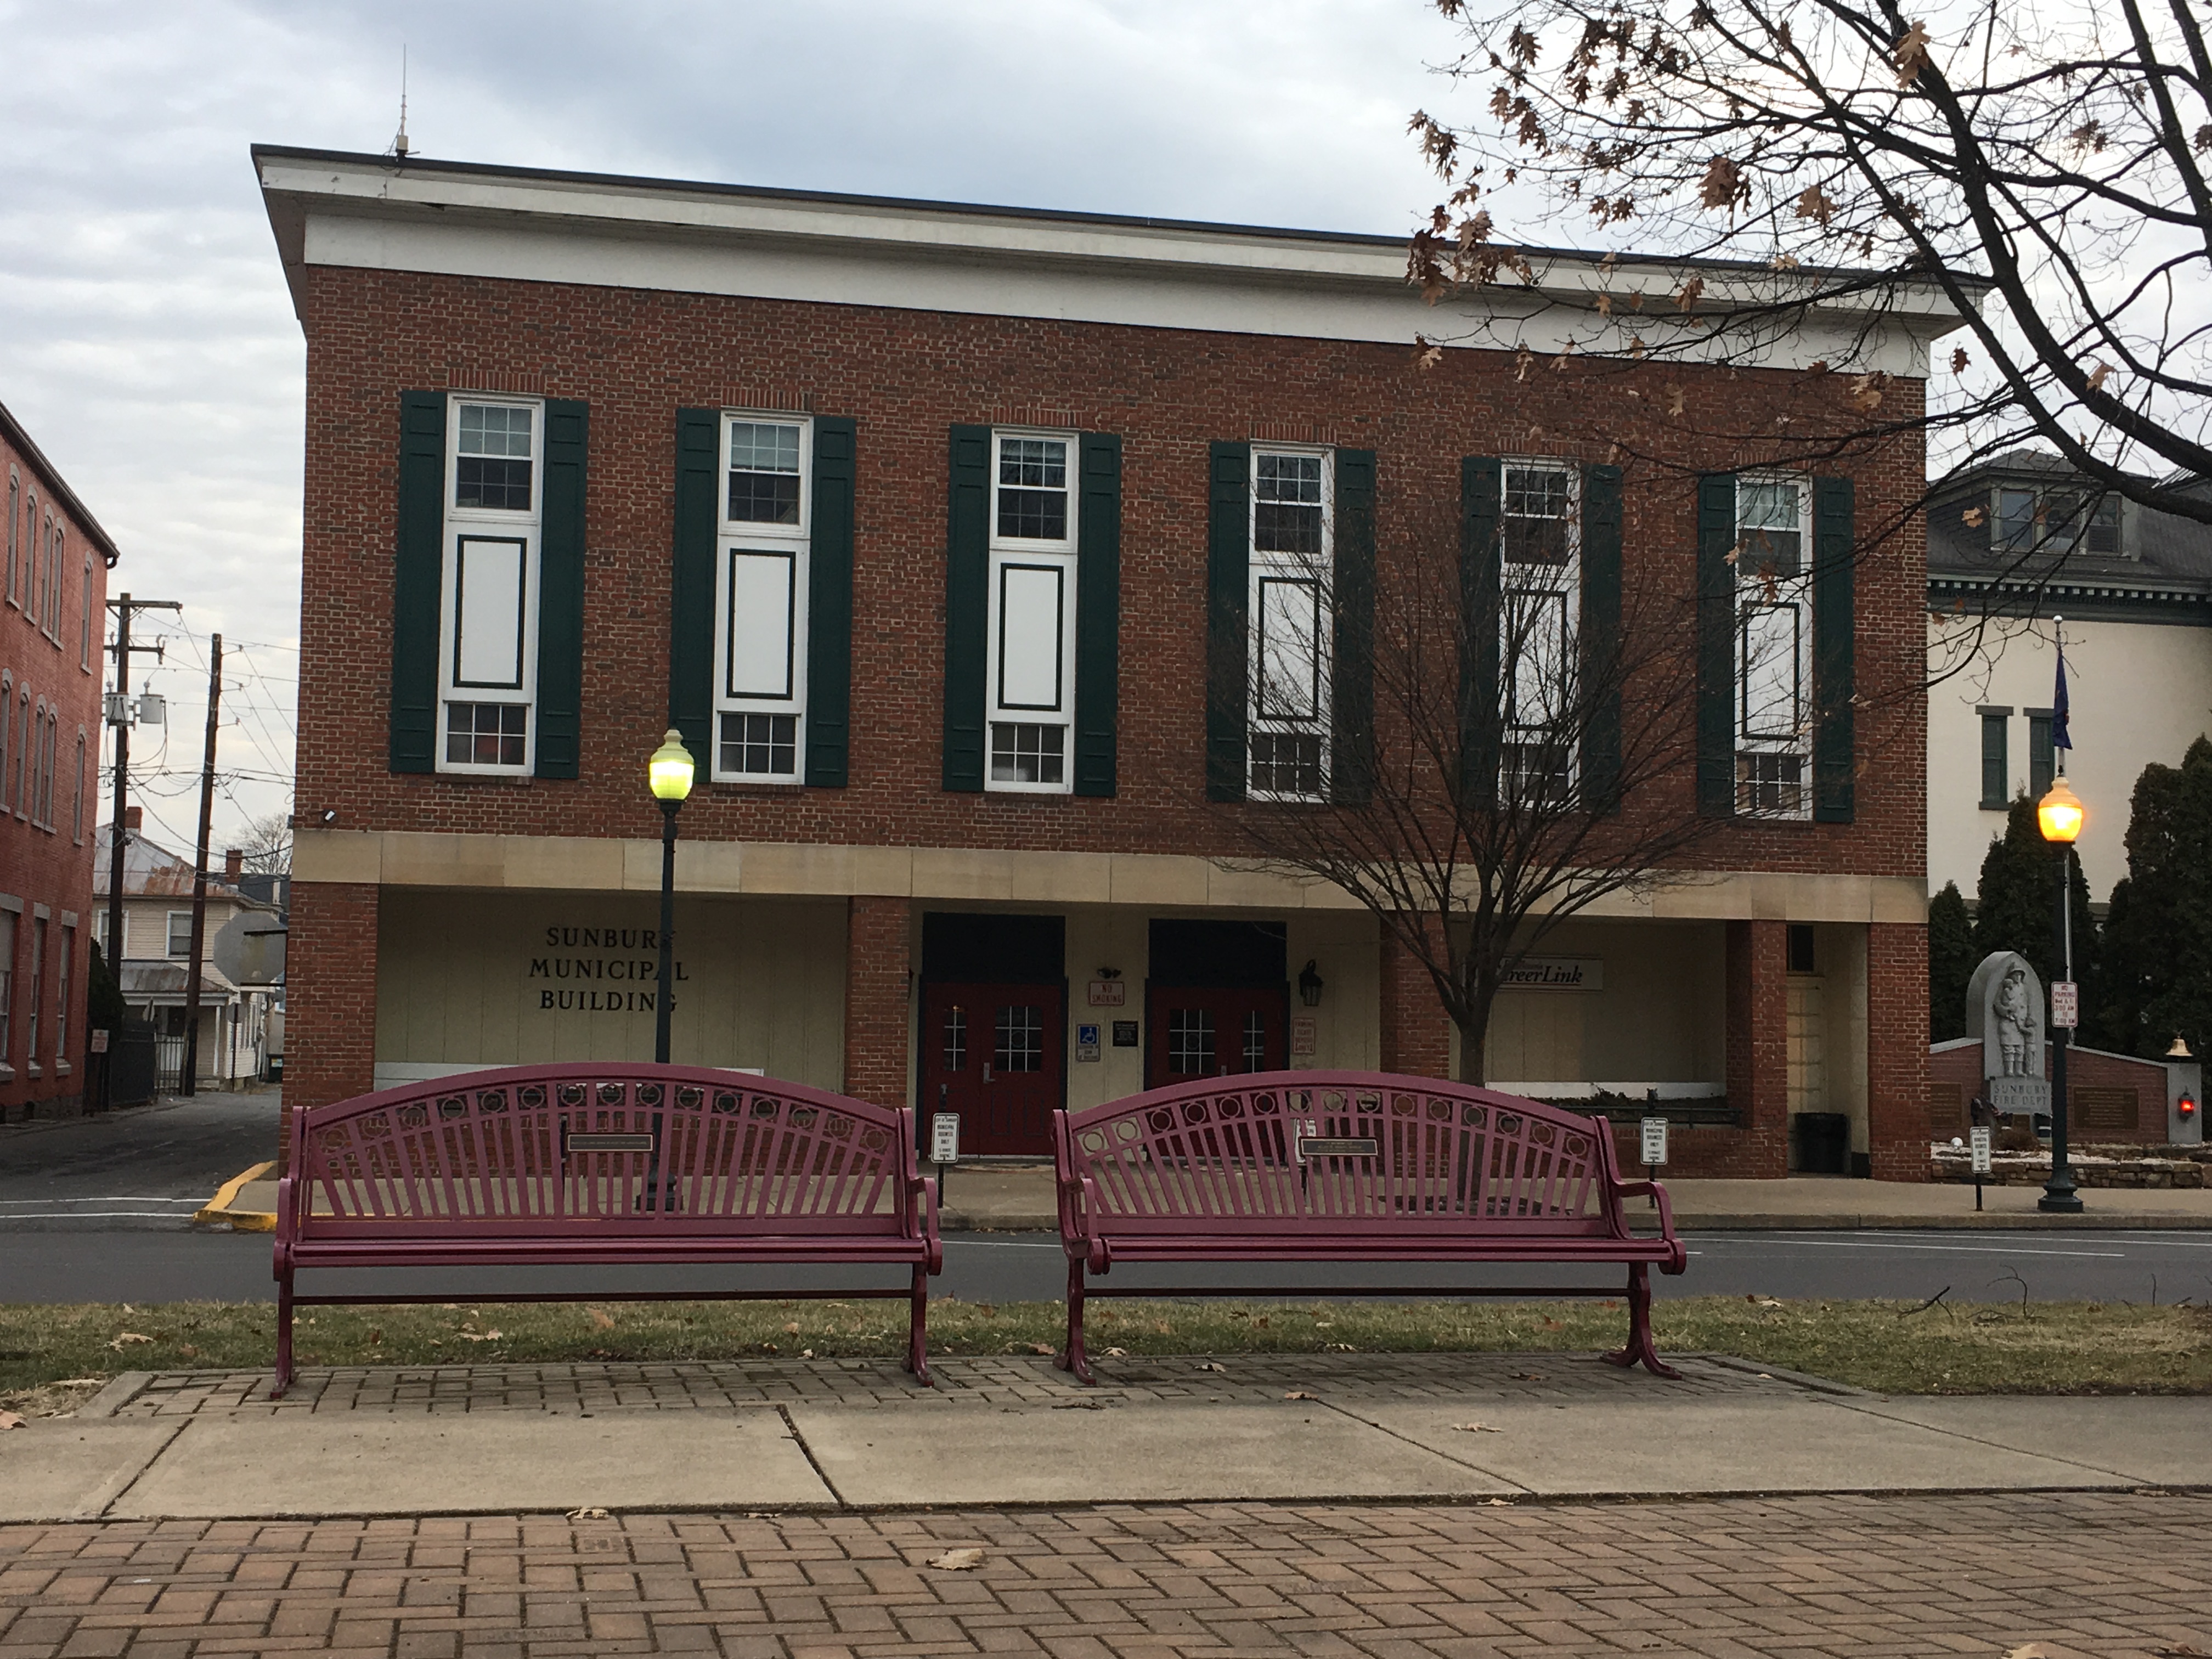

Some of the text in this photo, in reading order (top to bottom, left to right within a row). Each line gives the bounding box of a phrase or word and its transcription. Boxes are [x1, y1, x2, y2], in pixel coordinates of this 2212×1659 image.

[529, 959, 689, 980] MUNICIPL
[1504, 965, 1582, 983] reerLink
[1102, 984, 1112, 993] NO
[1092, 994, 1121, 1003] SMOKING
[1995, 1085, 2047, 1094] SUNBURY
[1994, 1096, 2046, 1105] FIRE DEPT
